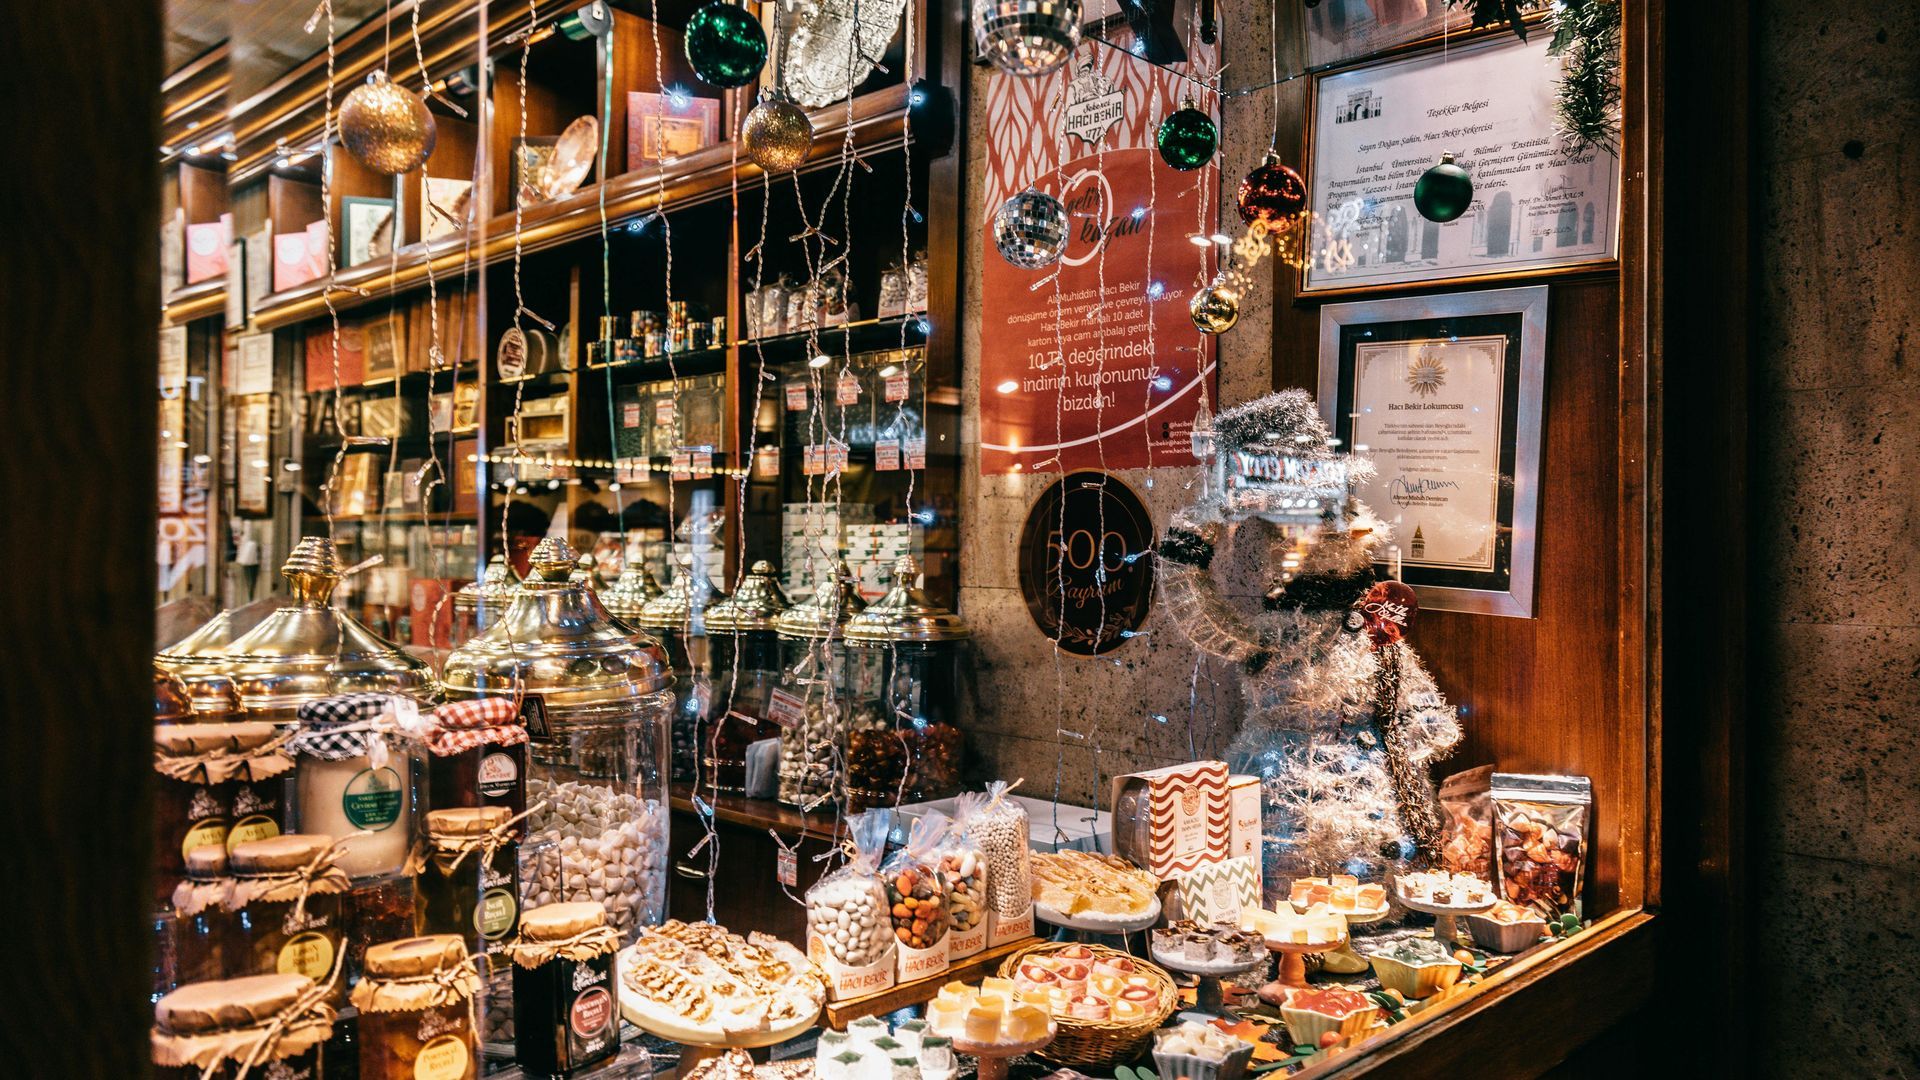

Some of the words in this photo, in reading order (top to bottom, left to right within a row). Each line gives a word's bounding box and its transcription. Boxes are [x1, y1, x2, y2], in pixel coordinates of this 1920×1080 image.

[1426, 106, 1462, 119] Teşekkür
[1462, 99, 1490, 114] Belgesi
[1068, 113, 1092, 130] HACI
[1085, 127, 1101, 140] 1777
[1358, 143, 1377, 154] Sayın
[1378, 139, 1400, 150] Doğan
[1423, 132, 1440, 142] Hacı
[1441, 128, 1461, 140] Bekir
[1461, 122, 1494, 137] Şekercisi
[1473, 144, 1502, 156] Bilimler
[1478, 155, 1515, 169] Geçmişten
[1517, 149, 1558, 163] Günümüze
[1476, 164, 1531, 179] katılımınızdan
[1535, 162, 1544, 170] ve
[1547, 158, 1567, 169] Hacı
[1571, 154, 1596, 165] Bekir
[1484, 179, 1508, 190] ederiz.
[1060, 289, 1097, 303] Muhiddin
[1119, 281, 1140, 294] Bekir
[1007, 310, 1047, 325] dönüşüme
[1049, 306, 1074, 318] önem
[1115, 293, 1147, 310] çevreyi
[1150, 289, 1185, 303] oruyor.
[1041, 321, 1058, 332] Hac
[1060, 318, 1080, 330] Bekir
[1081, 313, 1111, 325] maralı
[1113, 311, 1123, 321] 10
[1124, 309, 1144, 320] adet
[1027, 336, 1052, 348] karton
[1053, 334, 1072, 347] vya
[1073, 332, 1091, 342] cam
[1093, 326, 1126, 342] ambalaj
[1028, 353, 1043, 370] 10
[1068, 339, 1155, 366] değerindeki
[1023, 375, 1071, 393] indirim
[1075, 365, 1161, 391] kuponunuz
[1063, 391, 1115, 412] bizden!
[1388, 403, 1404, 411] Hacı
[1404, 403, 1422, 411] Bekir
[1423, 402, 1464, 411] Lokumcusu
[905, 960, 924, 973] HACI
[840, 975, 861, 991] HACI
